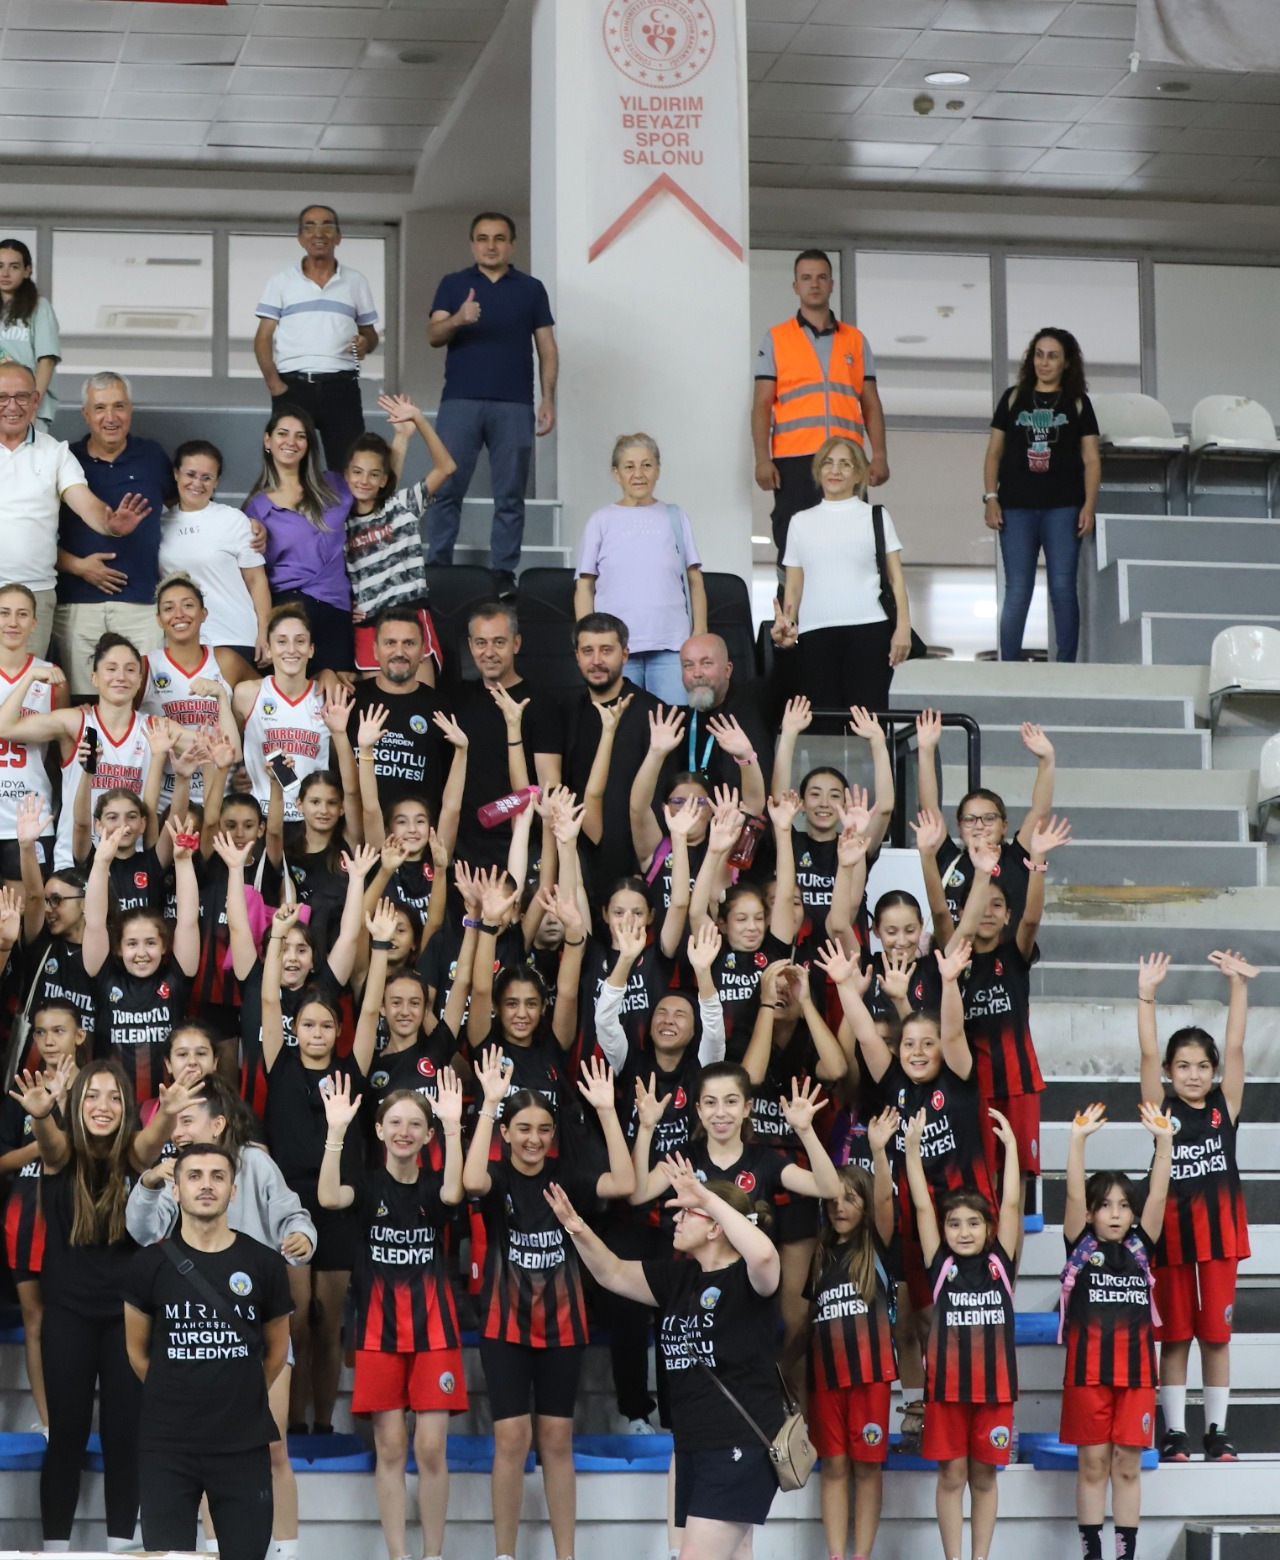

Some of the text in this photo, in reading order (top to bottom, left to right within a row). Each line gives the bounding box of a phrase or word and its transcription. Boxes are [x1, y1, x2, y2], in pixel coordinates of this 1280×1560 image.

[620, 96, 703, 111] YILDIRIM
[622, 114, 702, 129] BEYAZIT
[636, 132, 689, 147] SPOR
[623, 149, 703, 165] SALONU
[264, 727, 320, 744] TURGUTLU
[381, 737, 414, 747] GARDEN
[112, 1006, 170, 1025] TURGUTLU
[370, 1225, 436, 1244] TURGUTLU
[1089, 1272, 1147, 1288] TURGUTLU
[948, 1290, 1003, 1307] TURGUTLU
[1088, 1287, 1149, 1305] BELEDİYESİ
[946, 1306, 1006, 1326] BELEDİYESİ
[168, 1331, 242, 1345] TURGUTL
[167, 1343, 249, 1359] BELEDİYESİ
